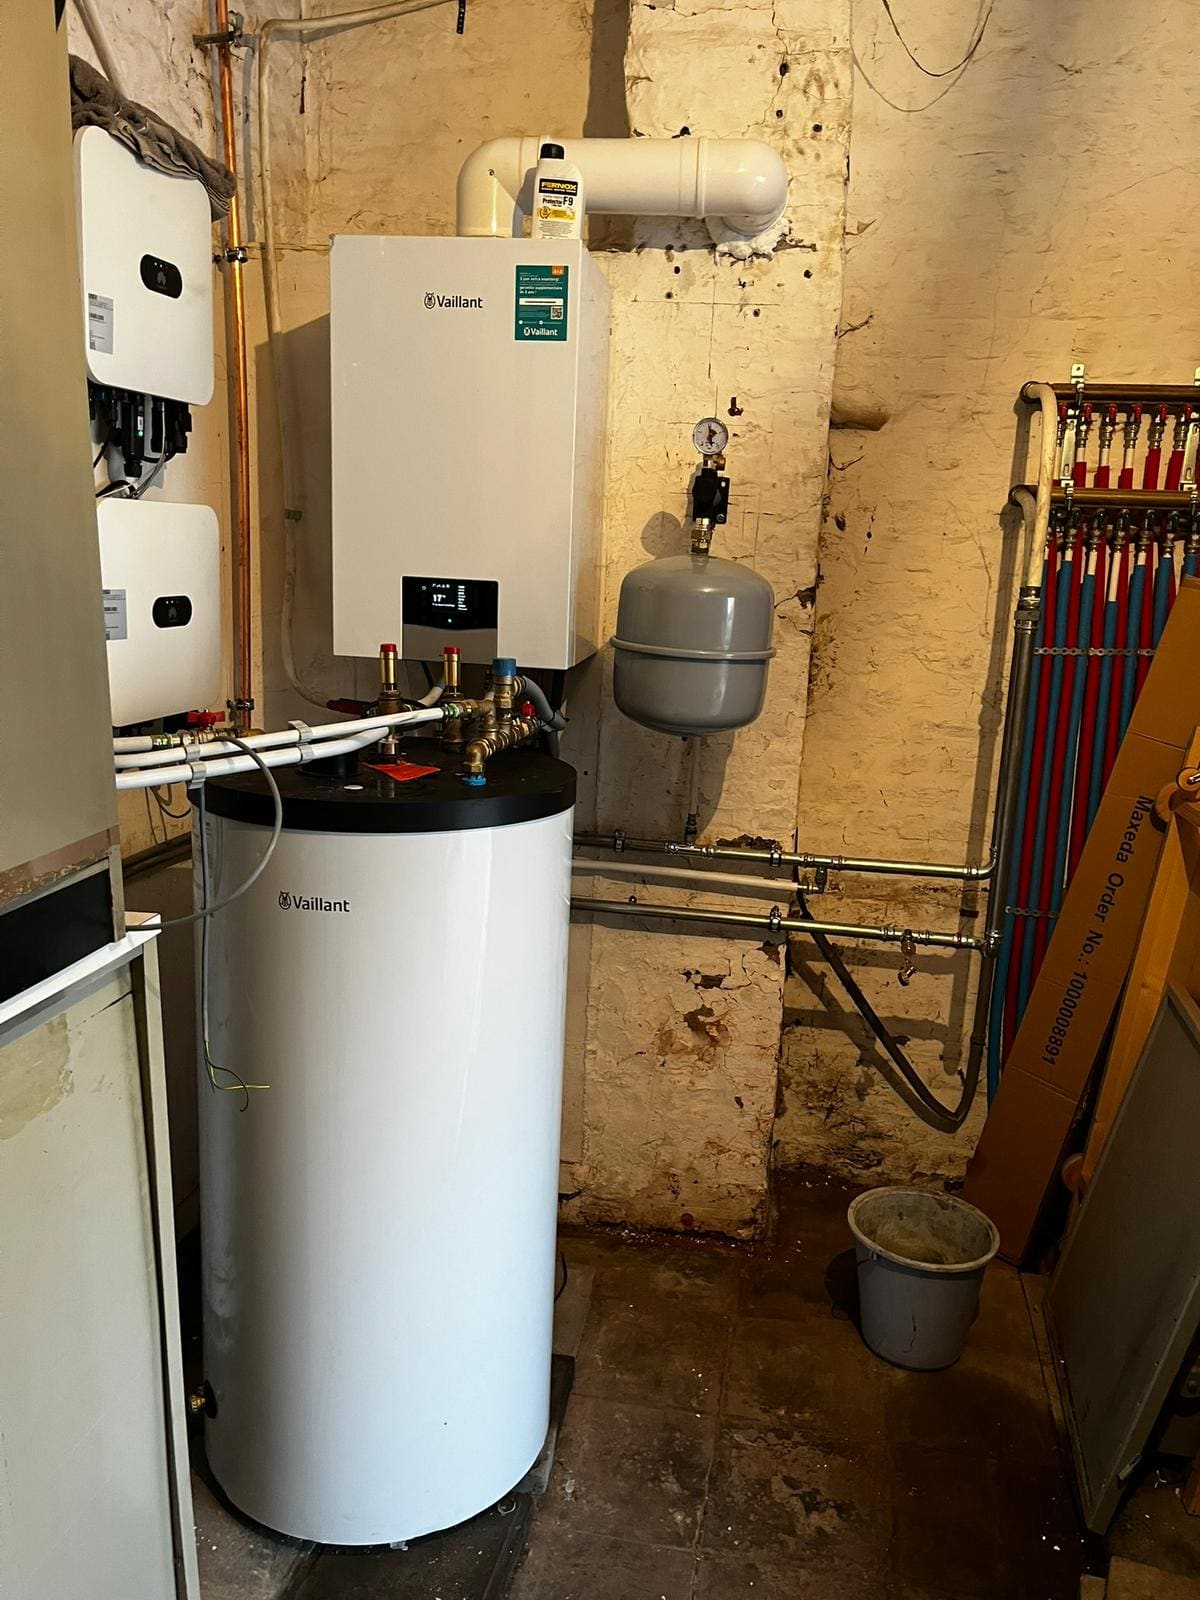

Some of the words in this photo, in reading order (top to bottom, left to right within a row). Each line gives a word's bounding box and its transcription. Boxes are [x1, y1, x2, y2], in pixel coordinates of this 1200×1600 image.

[563, 196, 574, 206] F9
[437, 295, 483, 309] Vaillant
[530, 327, 558, 336] Vaillant
[1116, 795, 1154, 863] Maxeda
[293, 895, 350, 912] Vaillant
[1095, 872, 1125, 923] Order
[1078, 929, 1104, 965] No.:
[1041, 971, 1088, 1066] 1000008891
